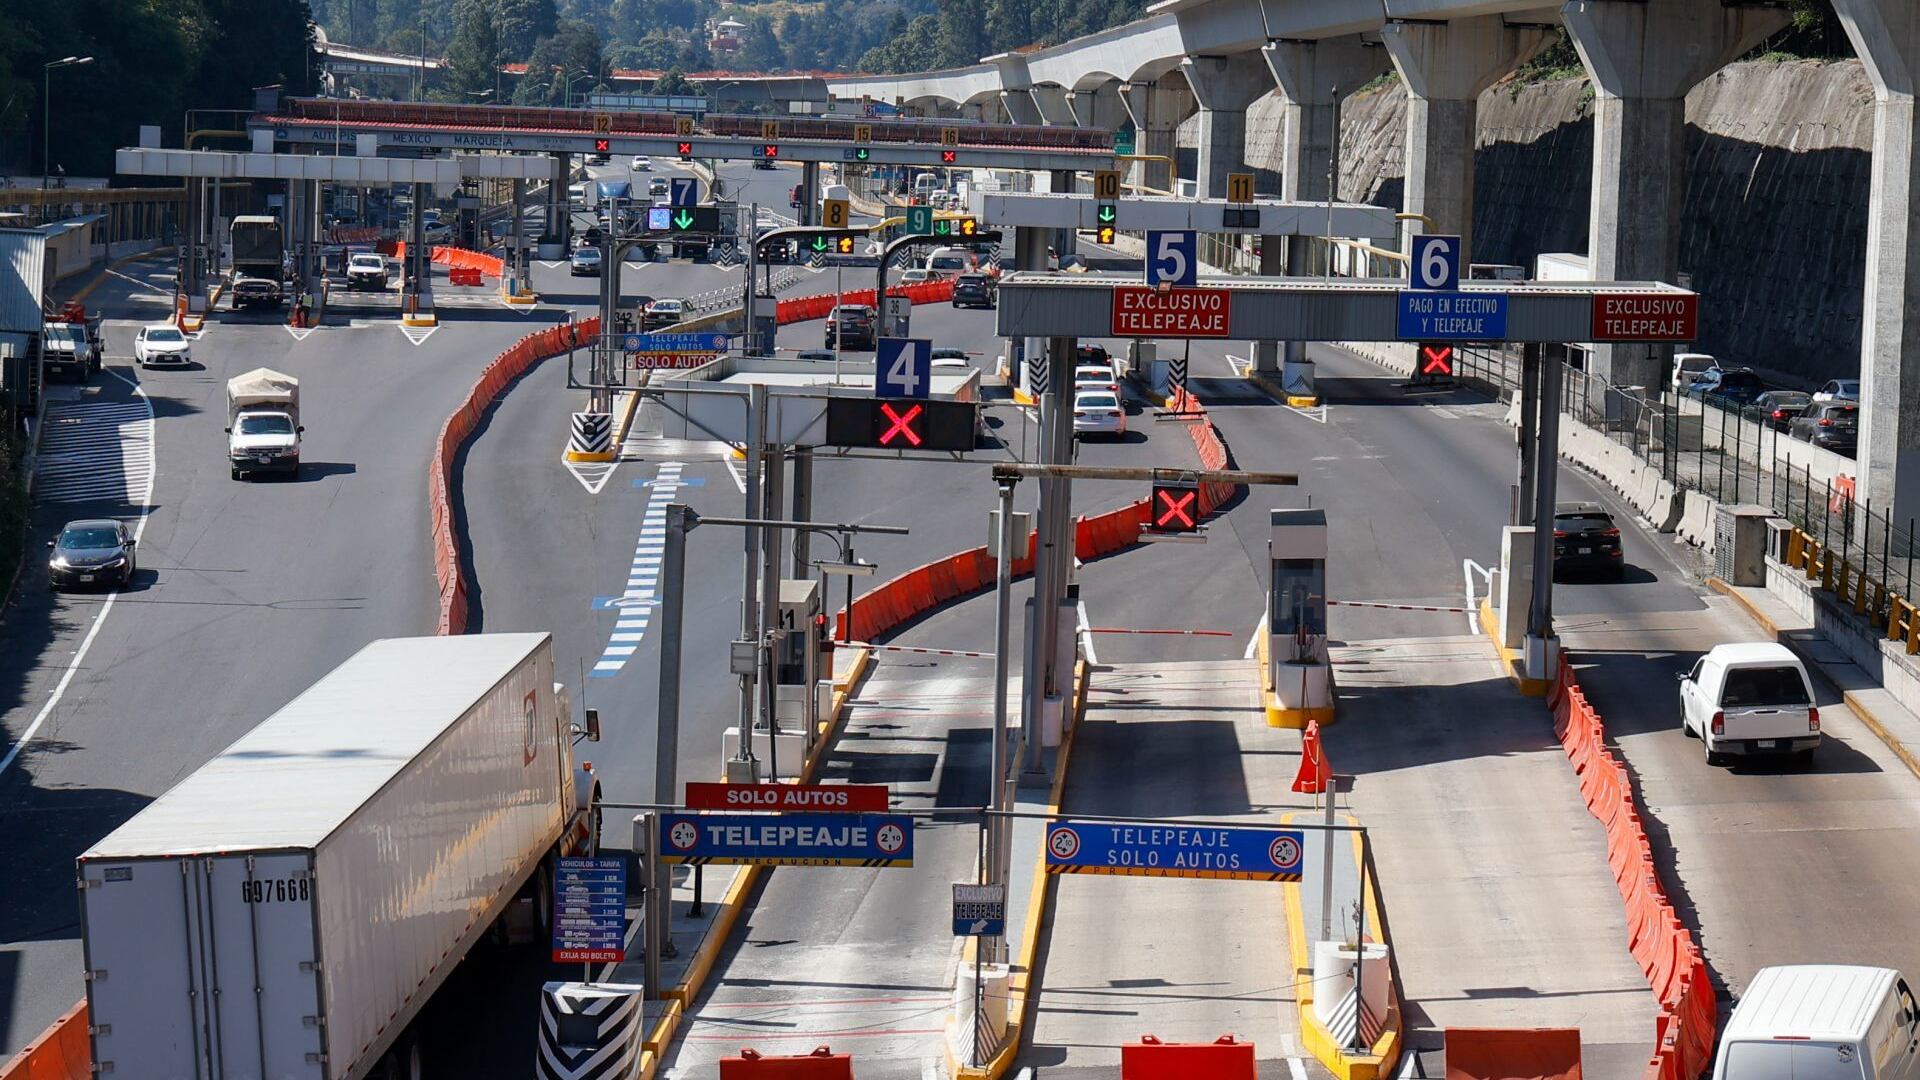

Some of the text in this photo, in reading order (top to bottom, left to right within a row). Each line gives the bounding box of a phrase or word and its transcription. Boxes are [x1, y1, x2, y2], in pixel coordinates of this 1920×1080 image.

[596, 118, 608, 131] 12
[678, 121, 691, 134] 13
[764, 124, 776, 137] 14
[312, 130, 513, 148] AUTOPIS MEXICO MARQUESA
[857, 127, 869, 140] 15
[944, 130, 956, 143] 16
[675, 179, 692, 205] 7
[1098, 174, 1116, 196] 10
[1233, 177, 1249, 200] 11
[830, 204, 841, 224] 8
[913, 210, 924, 230] 9
[1156, 233, 1187, 283] 5
[1421, 238, 1450, 287] 6
[1123, 293, 1221, 310] EXCLUSIVO
[1408, 297, 1498, 314] PAGO EN EFECTIVO
[1606, 299, 1685, 315] EXCLUSIVO
[1119, 312, 1224, 330] TELEPEAJE
[1422, 318, 1484, 333] Y TELEPEAJE
[1604, 319, 1685, 336] TELEPEAJE
[650, 334, 699, 343] TELEPEAJE
[649, 343, 704, 351] SOLO AUTOS
[637, 355, 715, 369] SOLO AUTOS
[886, 342, 920, 396] 4
[726, 789, 849, 806] SOLO AUTOS
[674, 830, 682, 840] 2
[706, 825, 868, 847] TELEPEAJE
[881, 833, 889, 843] 2
[1055, 836, 1064, 850] 2
[1111, 828, 1230, 848] TELEPEAJE
[1275, 845, 1284, 857] 2
[560, 860, 594, 868] VEHICULOS
[732, 858, 842, 866] PRECAUCION
[1107, 850, 1241, 869] SOLO AUTOS
[1093, 866, 1254, 881] PRECAUCION
[242, 878, 309, 903] 697668
[955, 886, 1003, 900] EXCLUSIVO
[956, 902, 1002, 920] TELEPEAJE
[560, 951, 616, 960] EXIJA SU BOLETO
